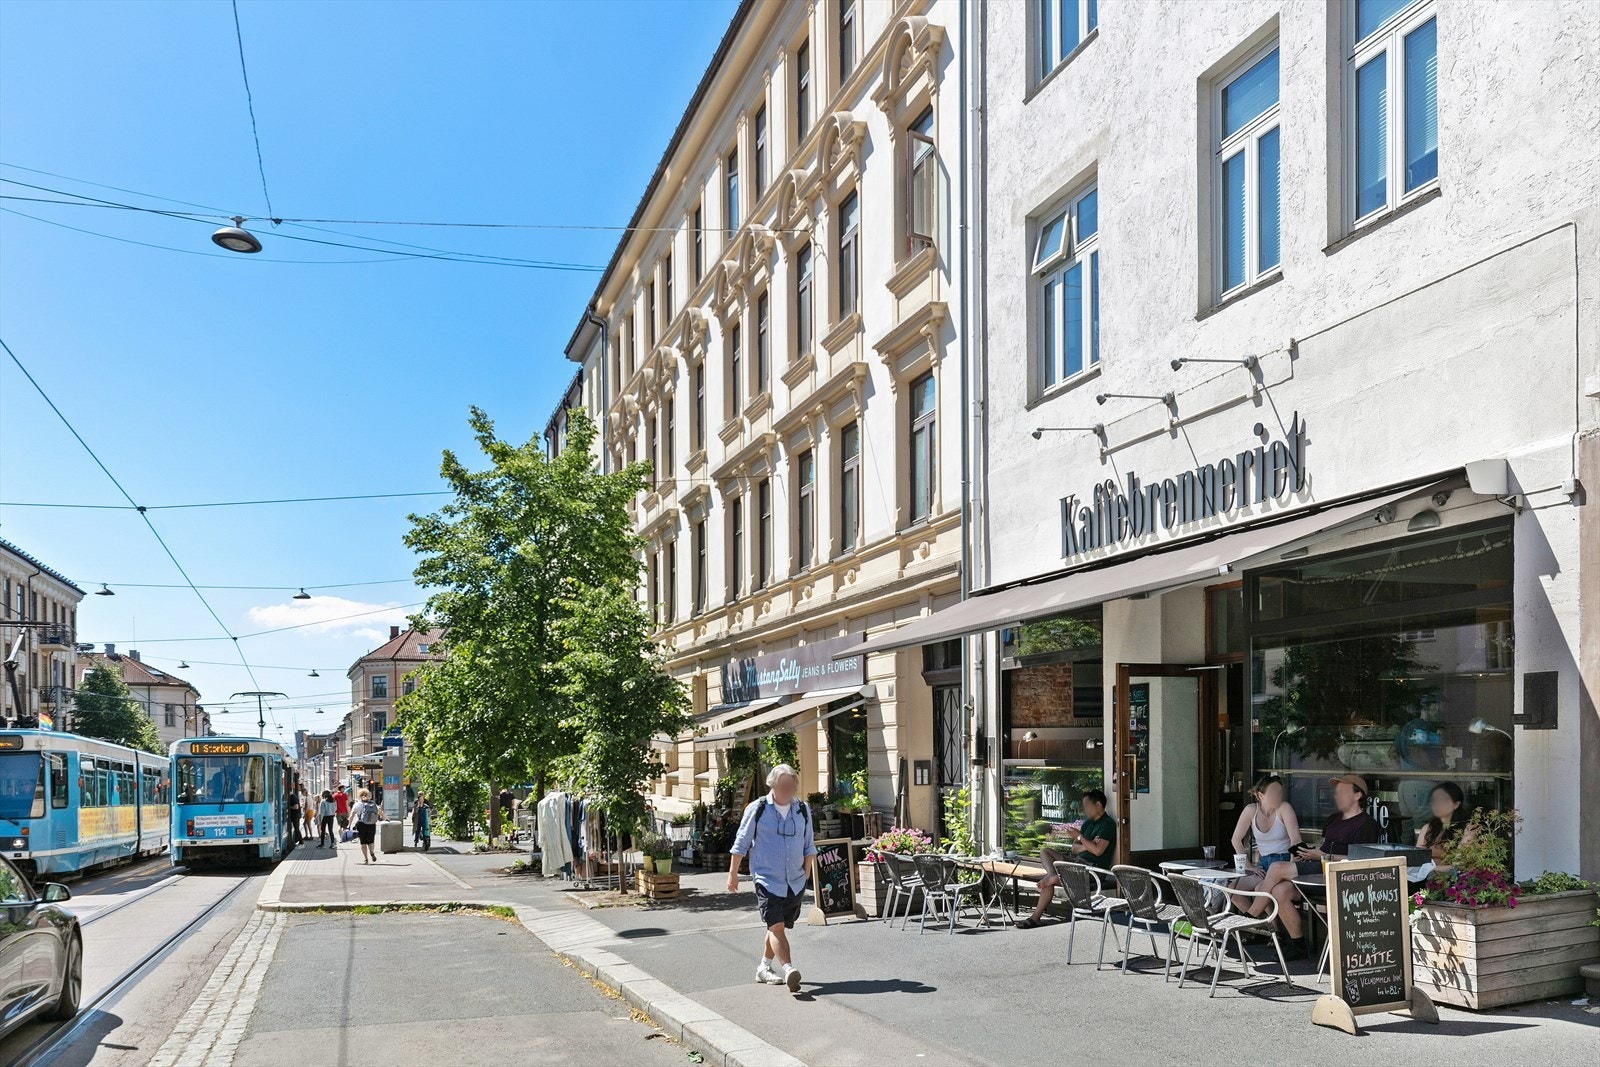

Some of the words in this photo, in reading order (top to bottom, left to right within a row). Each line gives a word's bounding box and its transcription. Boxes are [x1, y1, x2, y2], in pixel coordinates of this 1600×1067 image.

[1060, 410, 1306, 559] Kaffebrenneriet
[801, 665, 820, 678] JEANS
[821, 666, 826, 675] &
[827, 658, 858, 674] FLOWERS
[1041, 783, 1063, 806] Kaffe
[214, 828, 227, 837] 114
[817, 848, 842, 868] PINK
[1346, 949, 1396, 969] ISLATTE
